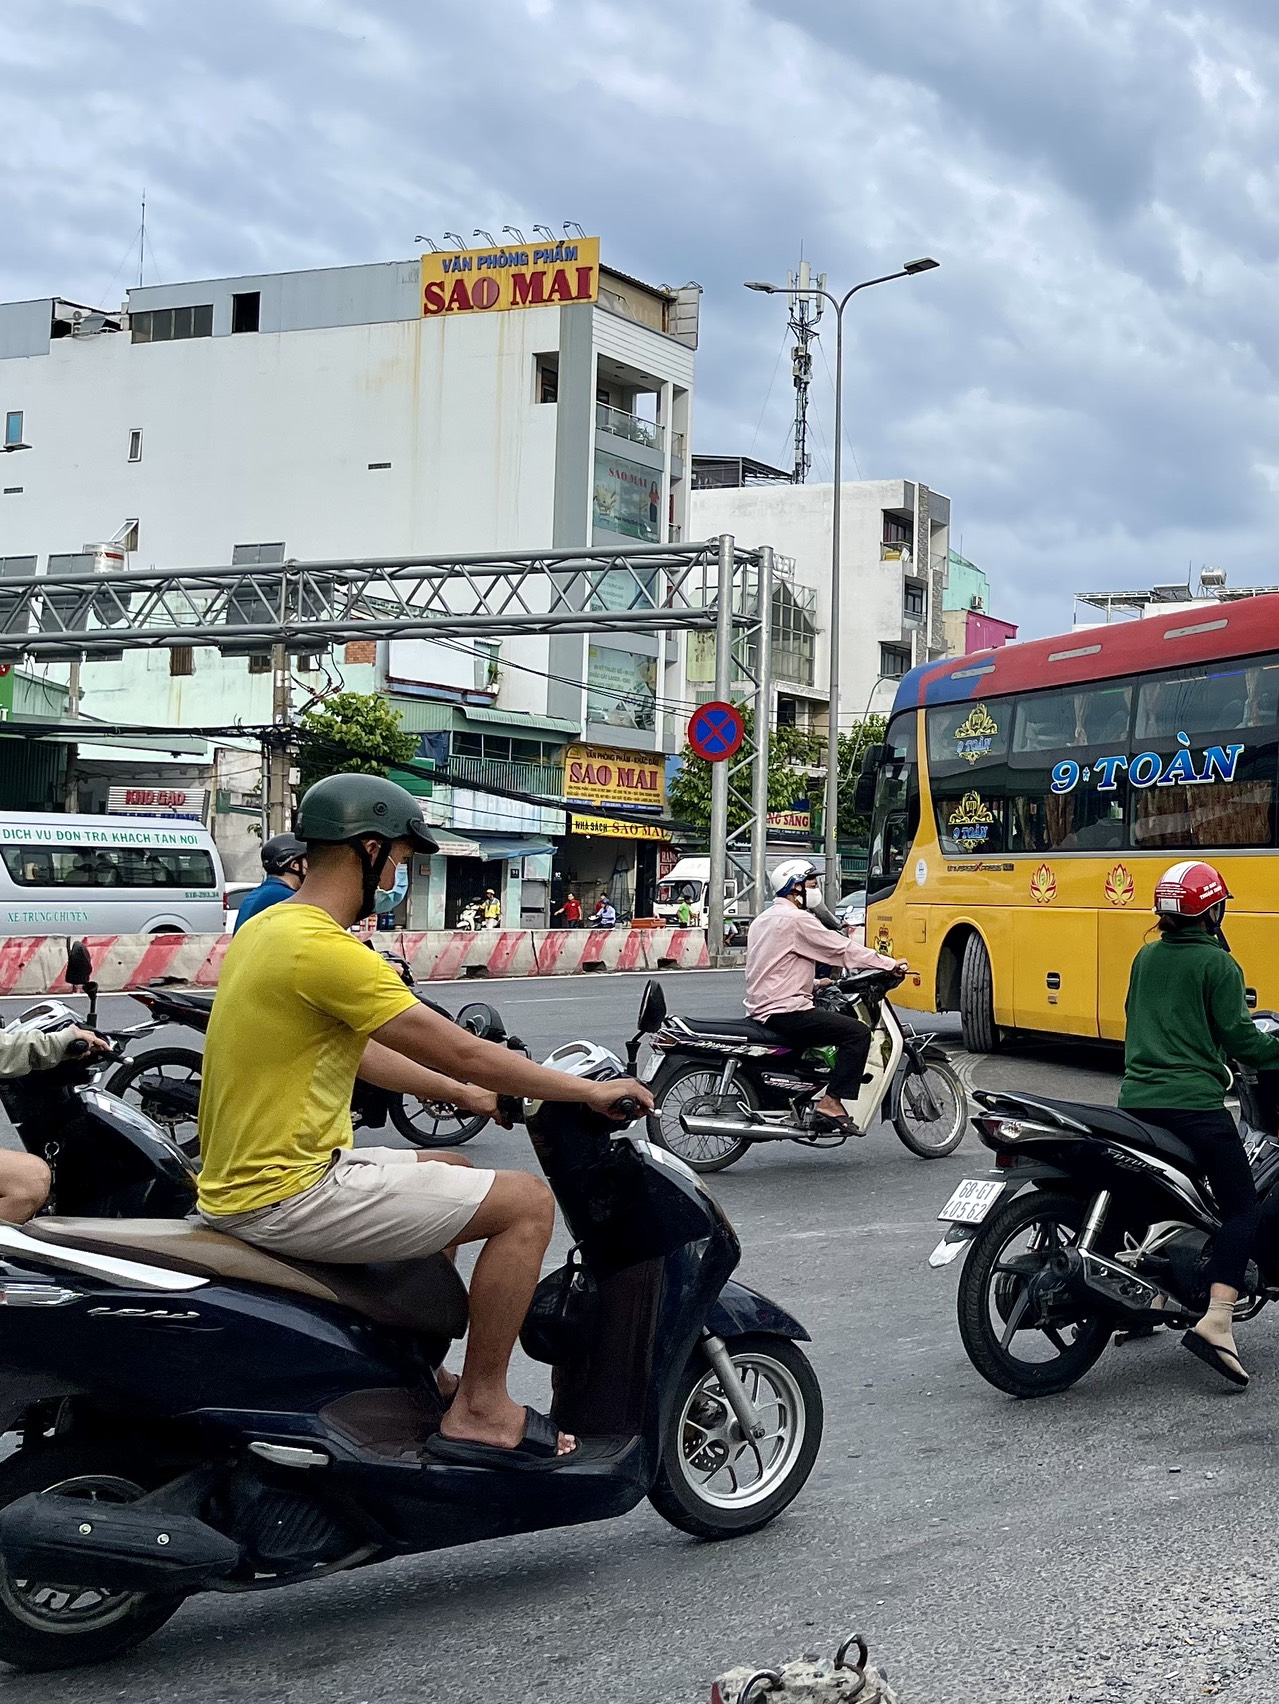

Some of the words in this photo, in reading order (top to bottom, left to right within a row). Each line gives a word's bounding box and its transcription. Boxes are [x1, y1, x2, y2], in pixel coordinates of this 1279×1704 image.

[442, 255, 472, 273] VĂN
[477, 249, 529, 270] PHÒNG
[533, 240, 578, 264] PHẨM
[424, 276, 500, 315] SAO
[511, 266, 593, 305] MAI
[608, 467, 628, 481] SAO
[630, 474, 647, 488] MAI
[1051, 759, 1080, 795] 9
[1093, 731, 1245, 792] TOÀN
[570, 762, 612, 786] SAO
[617, 767, 658, 790] MAI
[575, 820, 588, 831] NHÀ
[590, 820, 608, 832] SÁCH
[612, 821, 638, 835] SAO
[961, 823, 989, 839] TOÀN
[958, 1181, 996, 1200] 68-G1
